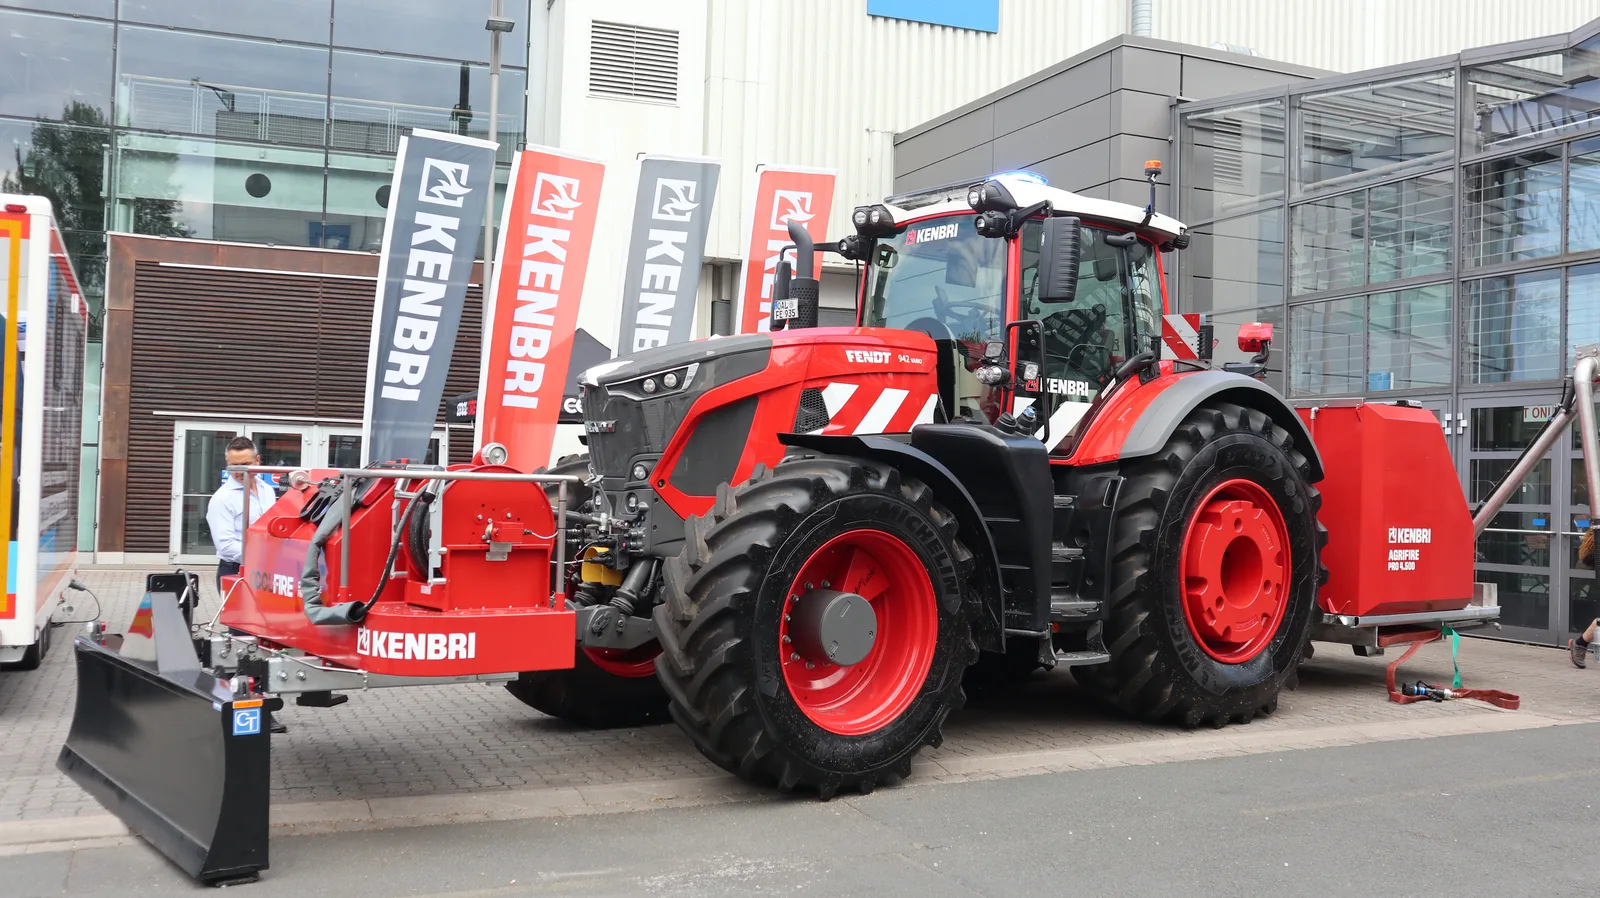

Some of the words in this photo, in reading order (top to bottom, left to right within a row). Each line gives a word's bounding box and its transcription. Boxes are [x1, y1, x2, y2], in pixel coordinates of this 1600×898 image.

[916, 223, 959, 243] KENBRI
[381, 211, 460, 402] KENBRI
[776, 310, 783, 319] FE
[785, 309, 796, 318] 935
[501, 224, 571, 409] KENBRI
[845, 350, 891, 364] FENDT
[898, 354, 910, 363] 942
[1397, 528, 1432, 544] KENBRI
[1388, 549, 1420, 561] AGRIFIRE
[1388, 561, 1399, 571] PRO
[372, 631, 476, 660] KENBRI
